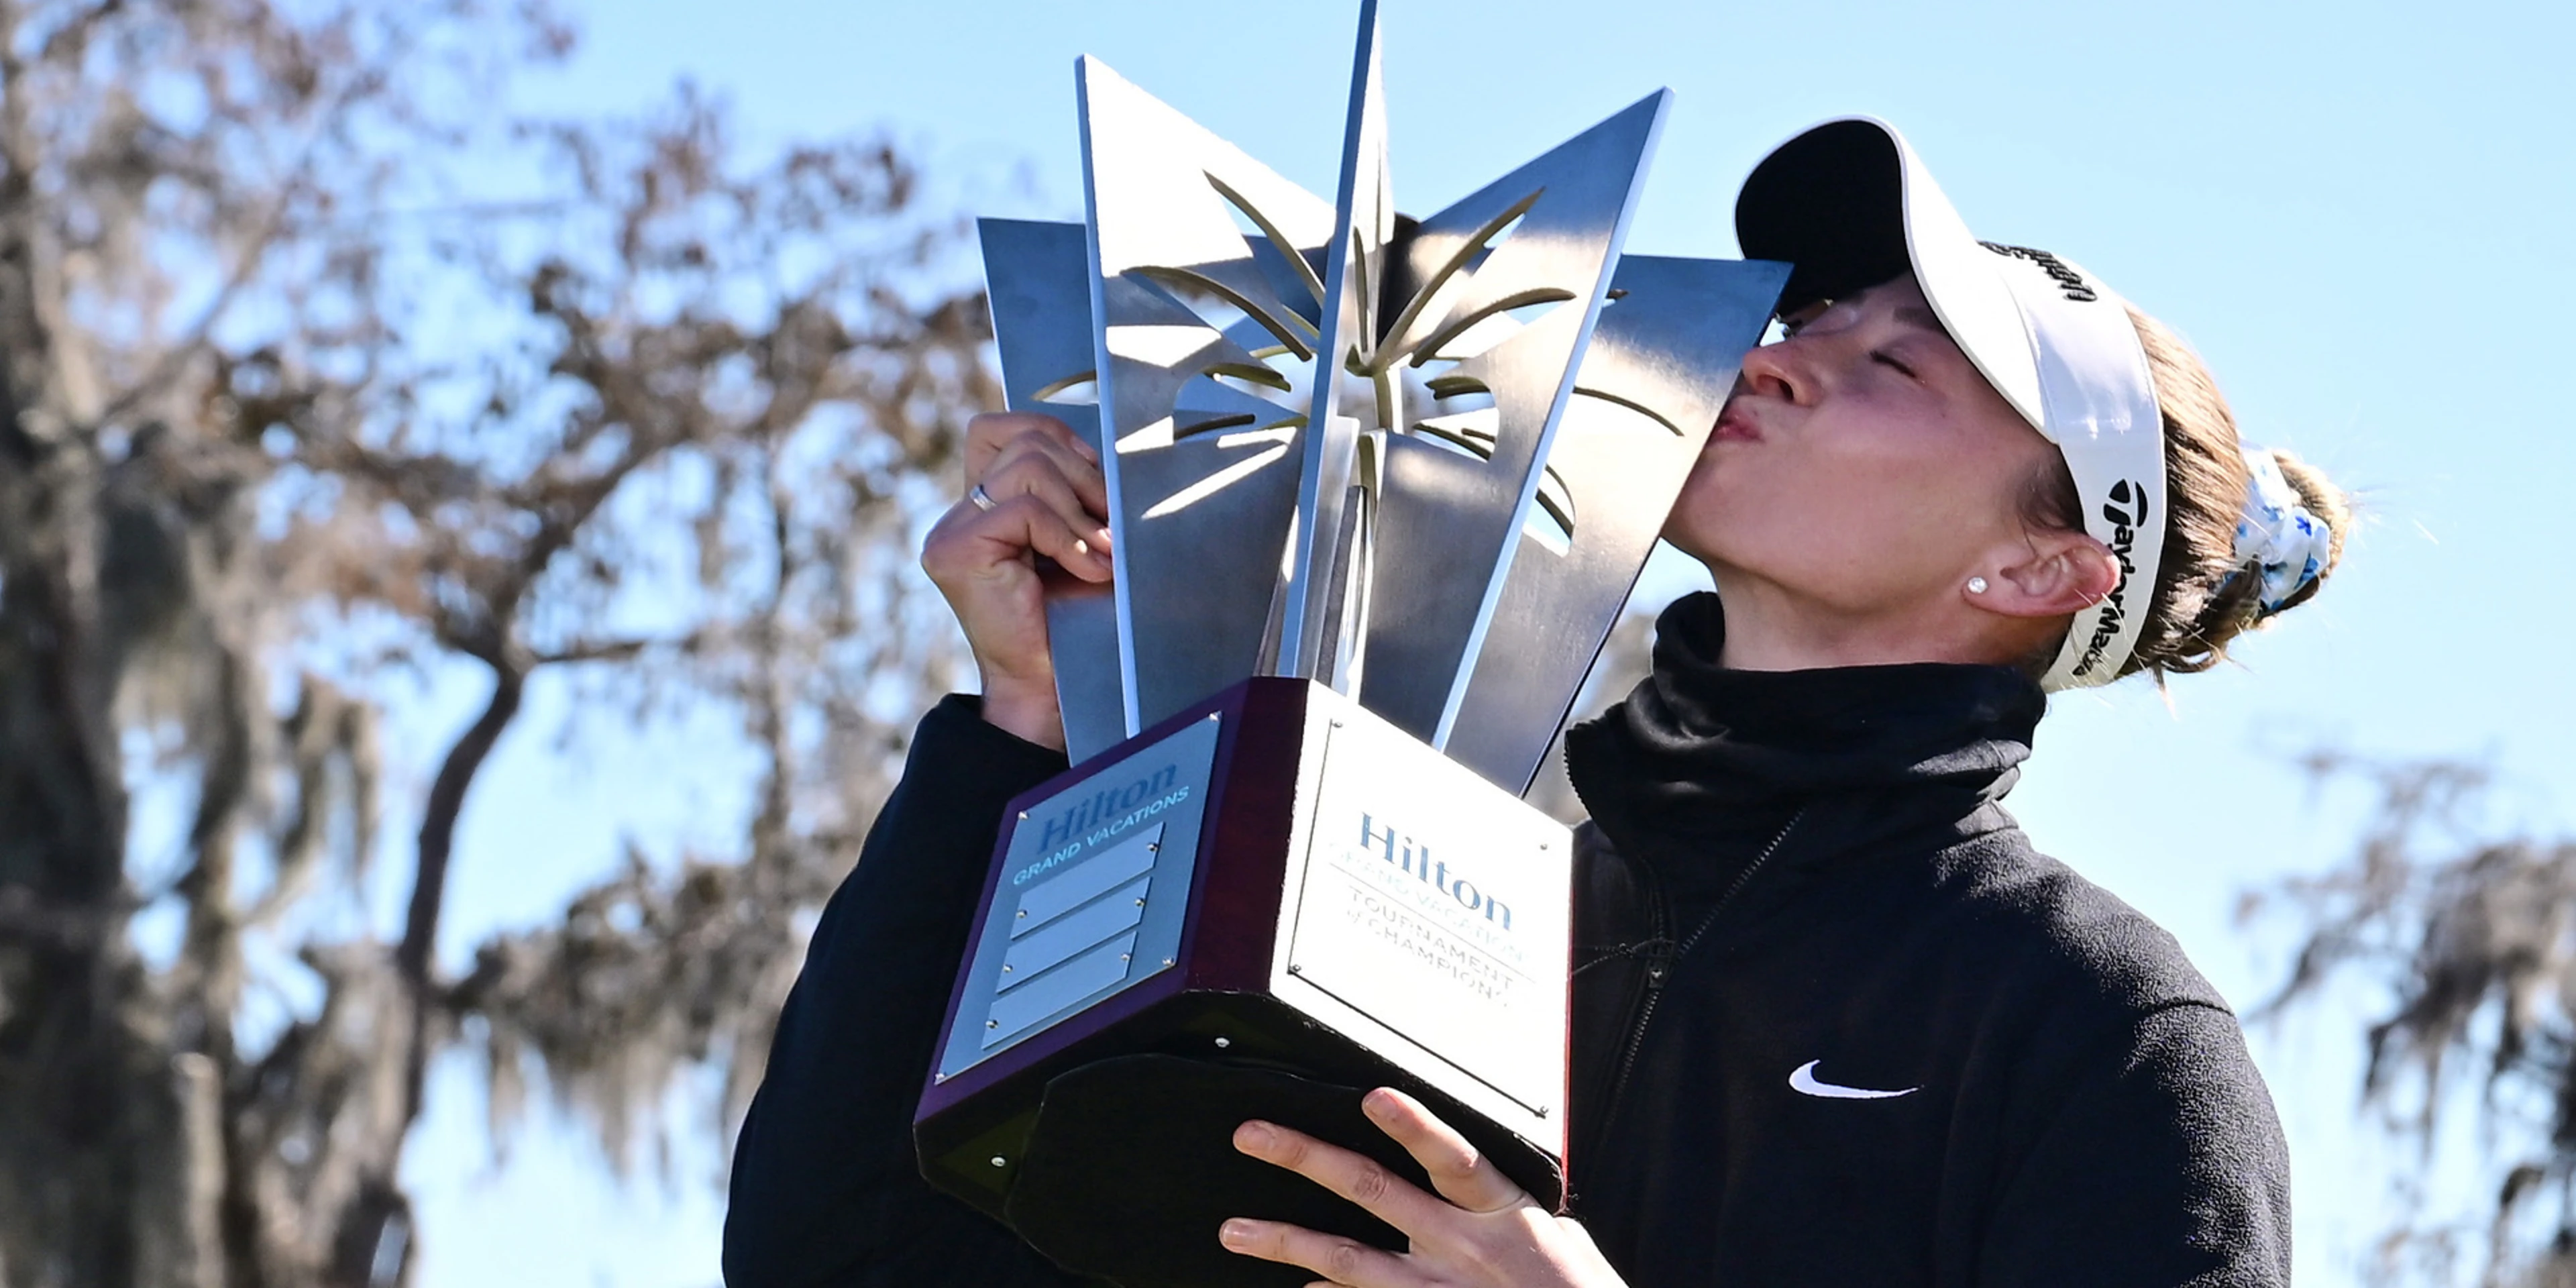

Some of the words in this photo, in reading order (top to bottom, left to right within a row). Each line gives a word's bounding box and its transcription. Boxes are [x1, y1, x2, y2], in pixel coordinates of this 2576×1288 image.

[1014, 842, 1080, 885] GRAND
[1087, 786, 1189, 847] VACATIONS
[1038, 764, 1177, 855] Hilton
[1360, 811, 1511, 931] Hilton
[1348, 885, 1513, 989] TOURNAMENT
[1416, 889, 1531, 963] VACATION
